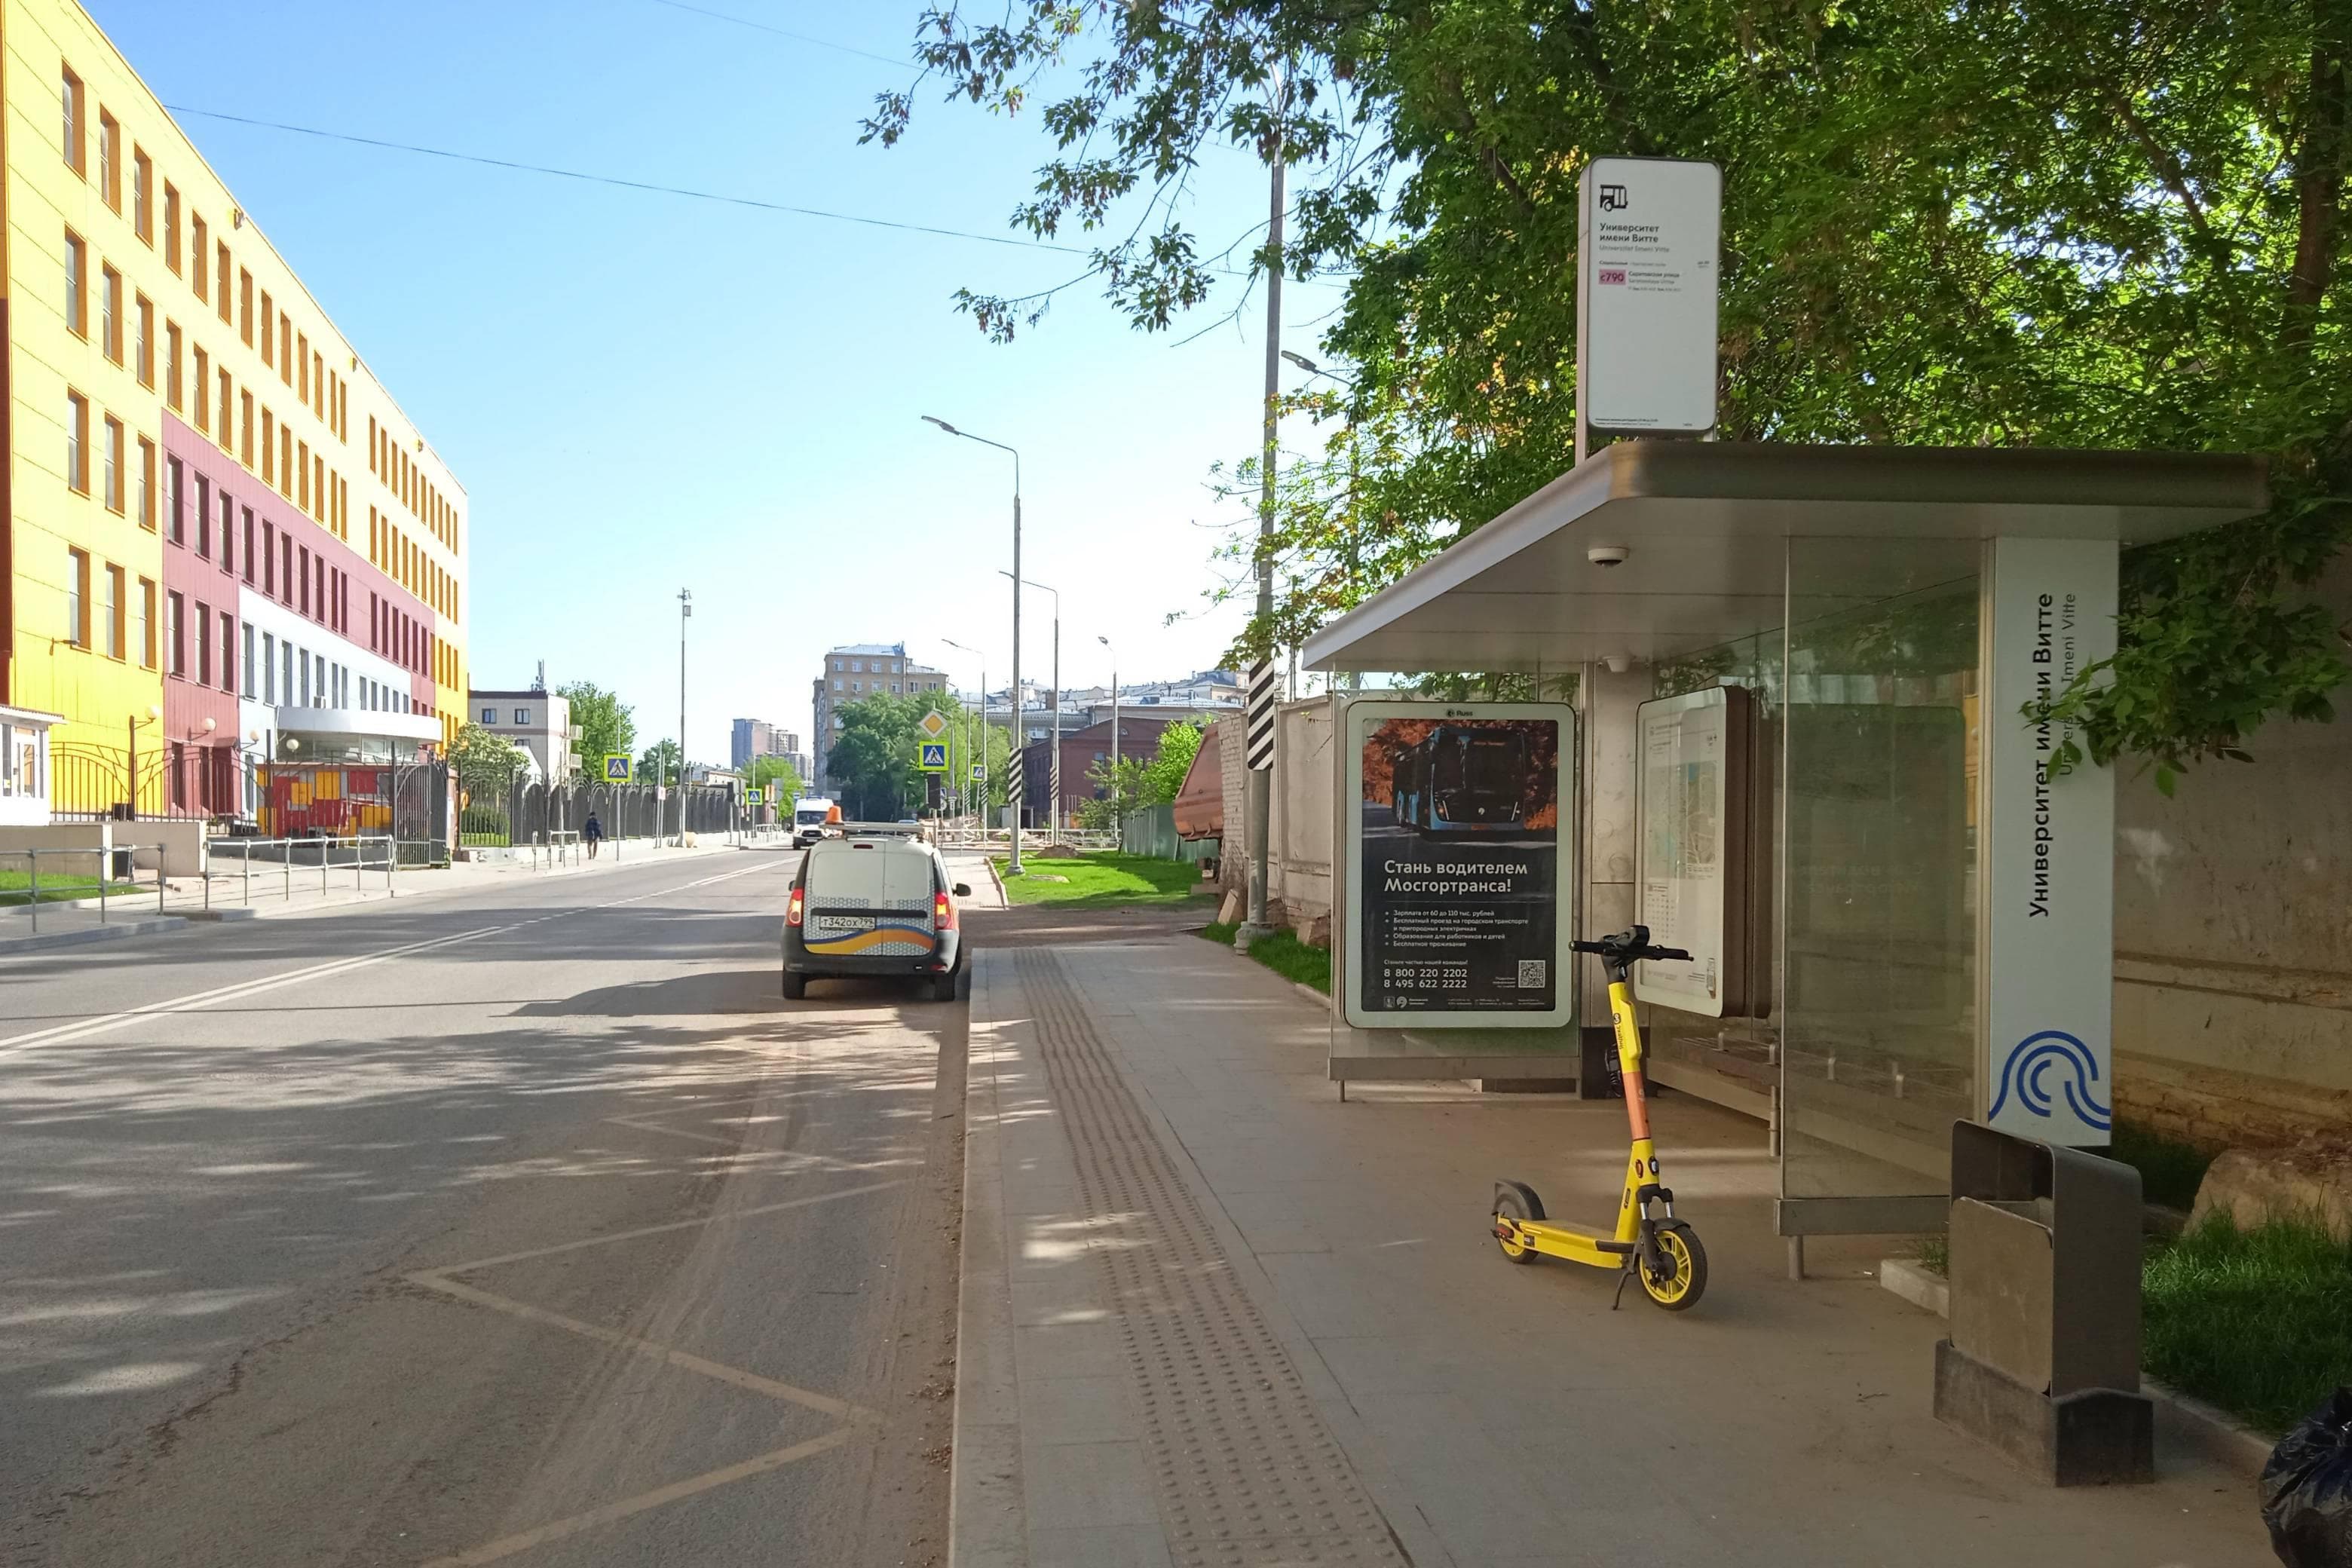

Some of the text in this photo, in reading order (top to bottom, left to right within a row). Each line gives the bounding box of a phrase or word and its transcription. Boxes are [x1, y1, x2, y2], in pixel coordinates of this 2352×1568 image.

[1599, 222, 1660, 234] Университет
[1632, 234, 1659, 243] Витте
[2062, 593, 2076, 630] Vitte
[2032, 593, 2053, 663] Витте
[2062, 635, 2075, 683] Imeni
[2029, 759, 2053, 917] Университет
[1384, 860, 1528, 876] Стань водителем
[1384, 878, 1511, 895] Мосгортранса!
[1472, 909, 1495, 917] рублей
[1384, 969, 1468, 978] 8 800 220 2202
[1384, 980, 1467, 988] 8 495 622 2222
